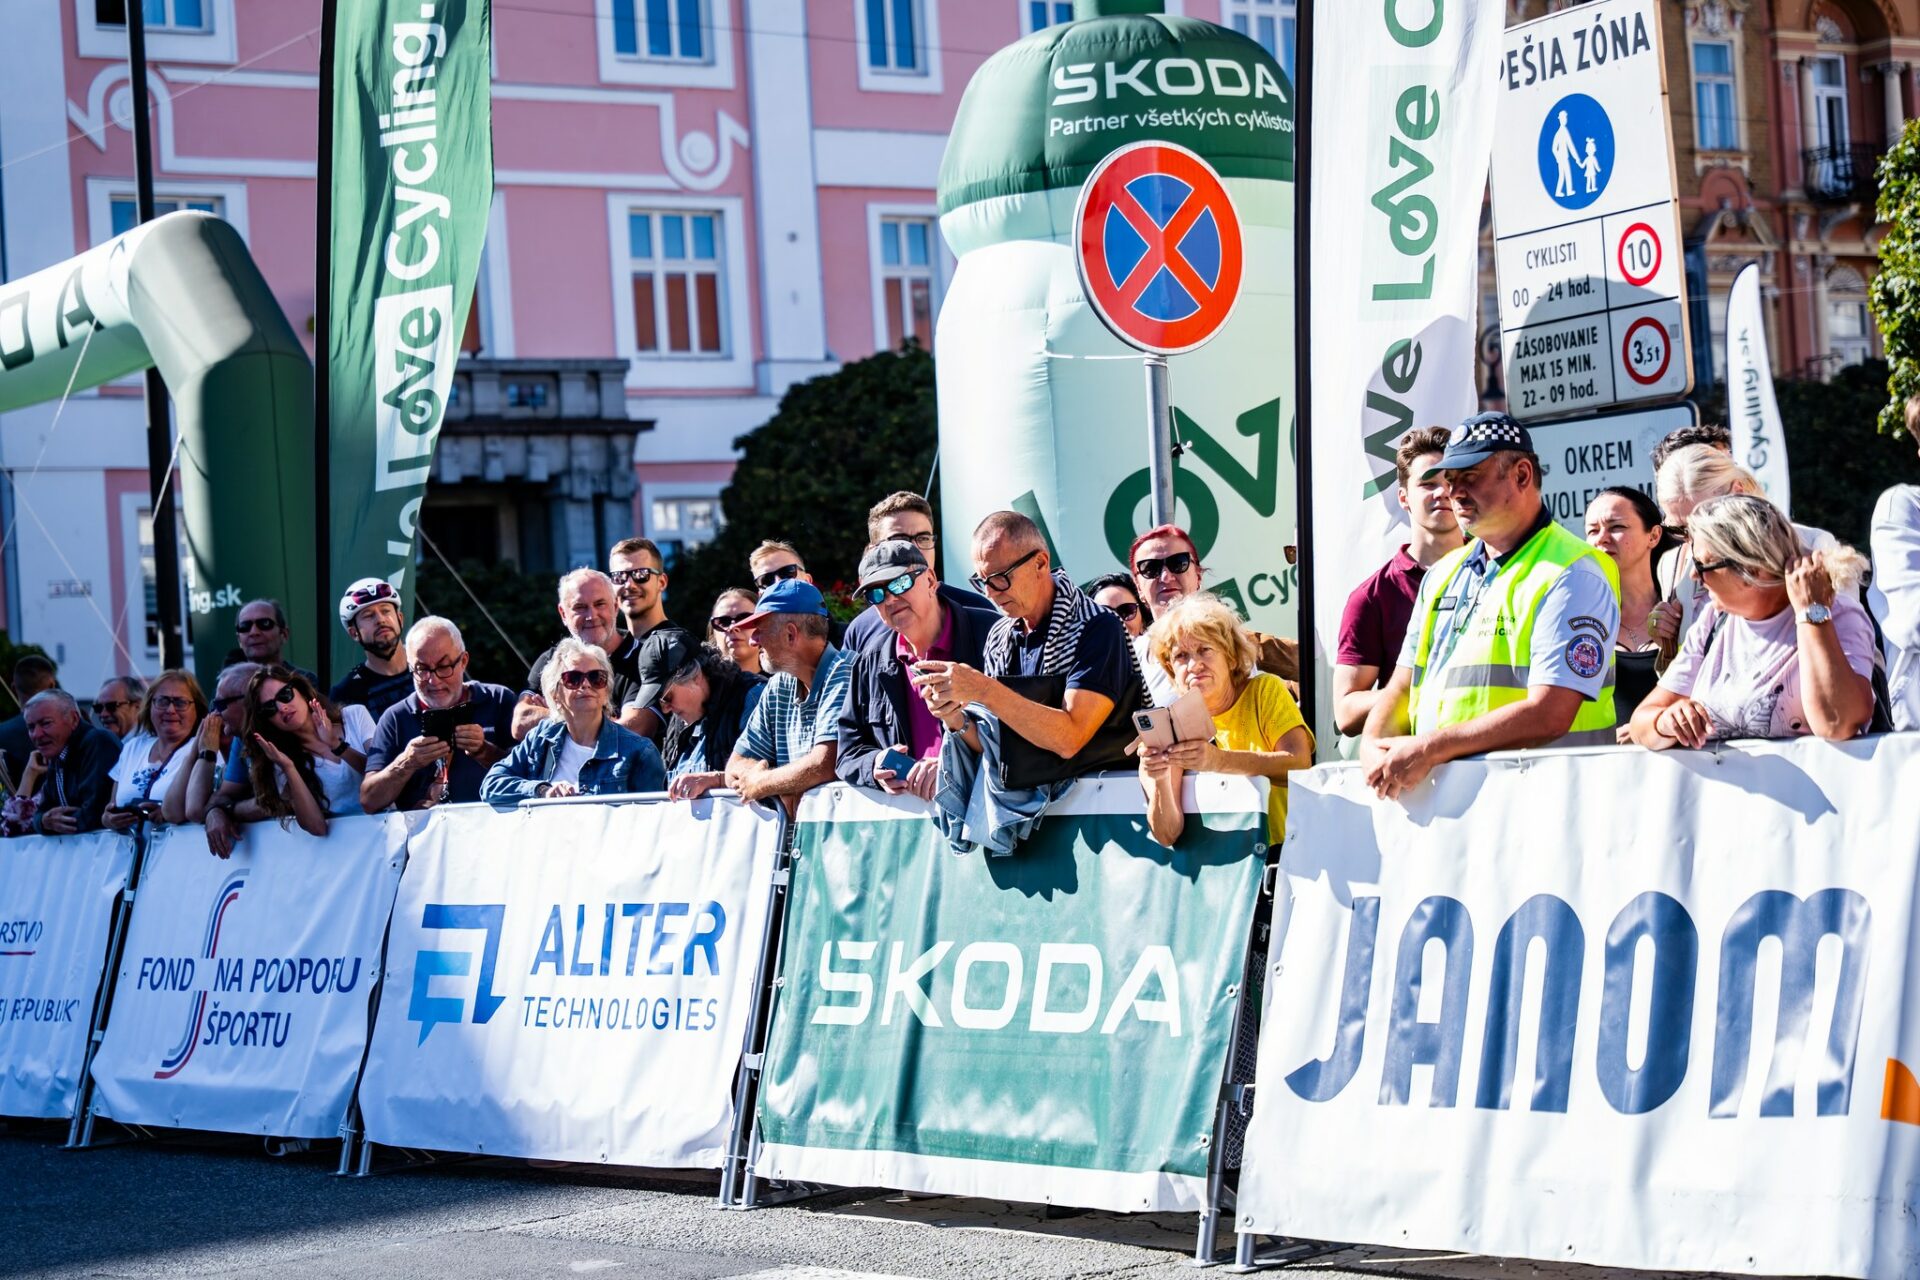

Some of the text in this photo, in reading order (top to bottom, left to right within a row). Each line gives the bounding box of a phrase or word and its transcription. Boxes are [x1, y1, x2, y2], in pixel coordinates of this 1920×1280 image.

[1500, 12, 1650, 91] EŠIA ZÓNA
[1050, 114, 1128, 137] Partner
[1135, 107, 1231, 130] všetkých
[379, 3, 451, 281] Cycling.
[1371, 84, 1440, 301] Love
[1526, 242, 1577, 270] CYKLISTI
[1627, 239, 1651, 271] 10
[1513, 287, 1529, 308] 00
[1547, 281, 1563, 302] 24
[1568, 273, 1595, 299] hod.
[1515, 326, 1598, 360] ZÁSOBOVANIE
[1520, 353, 1596, 385] MAX 15 MIN.
[1522, 389, 1537, 409] 22
[1550, 384, 1565, 404] 09
[1570, 378, 1598, 401] hod.
[1565, 440, 1633, 475] OKREM
[530, 900, 726, 976] ALITER
[137, 957, 195, 991] FOND
[213, 958, 244, 992] NA
[523, 996, 718, 1031] TECHNOLOGIES
[1284, 888, 1873, 1120] JANOM
[202, 1001, 291, 1048] ŠPORTU
